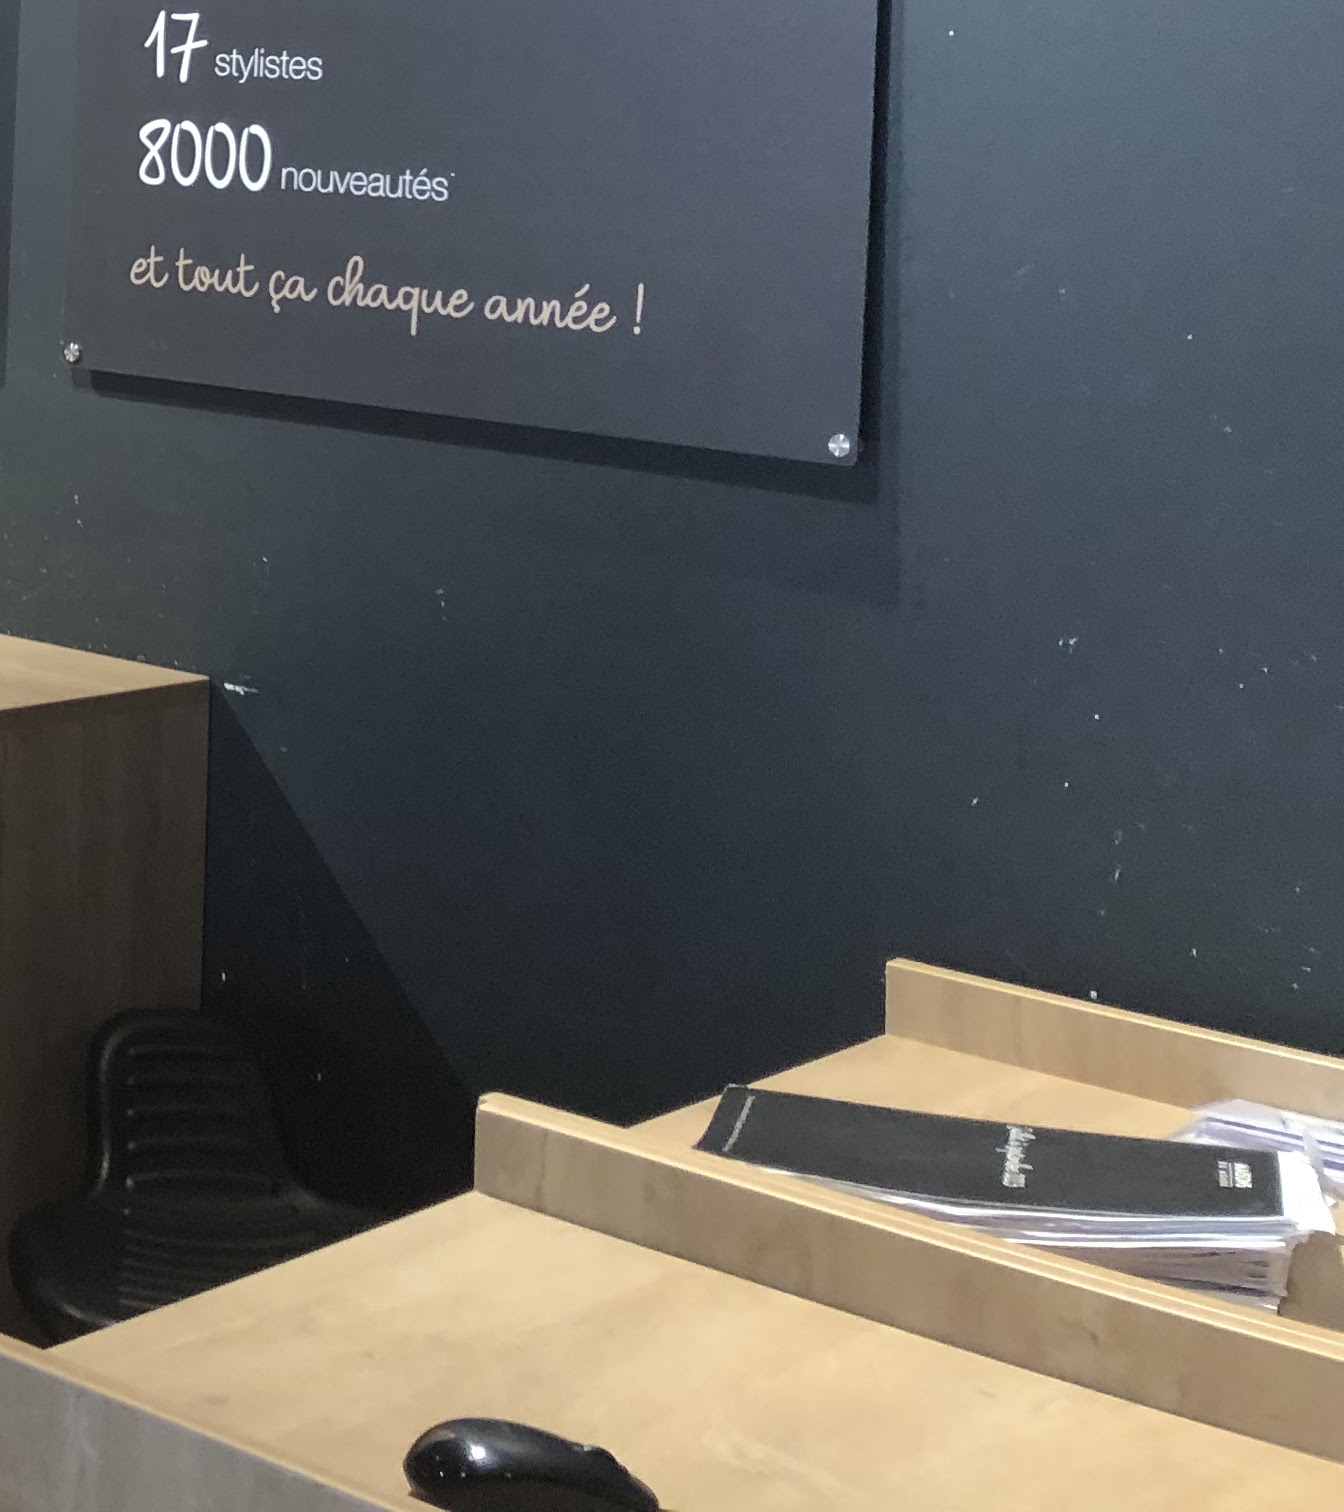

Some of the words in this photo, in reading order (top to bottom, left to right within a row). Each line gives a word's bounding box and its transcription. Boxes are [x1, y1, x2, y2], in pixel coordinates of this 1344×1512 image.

[143, 9, 209, 84] 17
[214, 47, 324, 84] stylistes
[138, 118, 273, 192] 8000
[129, 244, 170, 289] et
[174, 247, 260, 298] tout
[268, 269, 319, 314] ça
[326, 255, 476, 337] chaque
[483, 283, 618, 334] année
[632, 282, 645, 336] !
